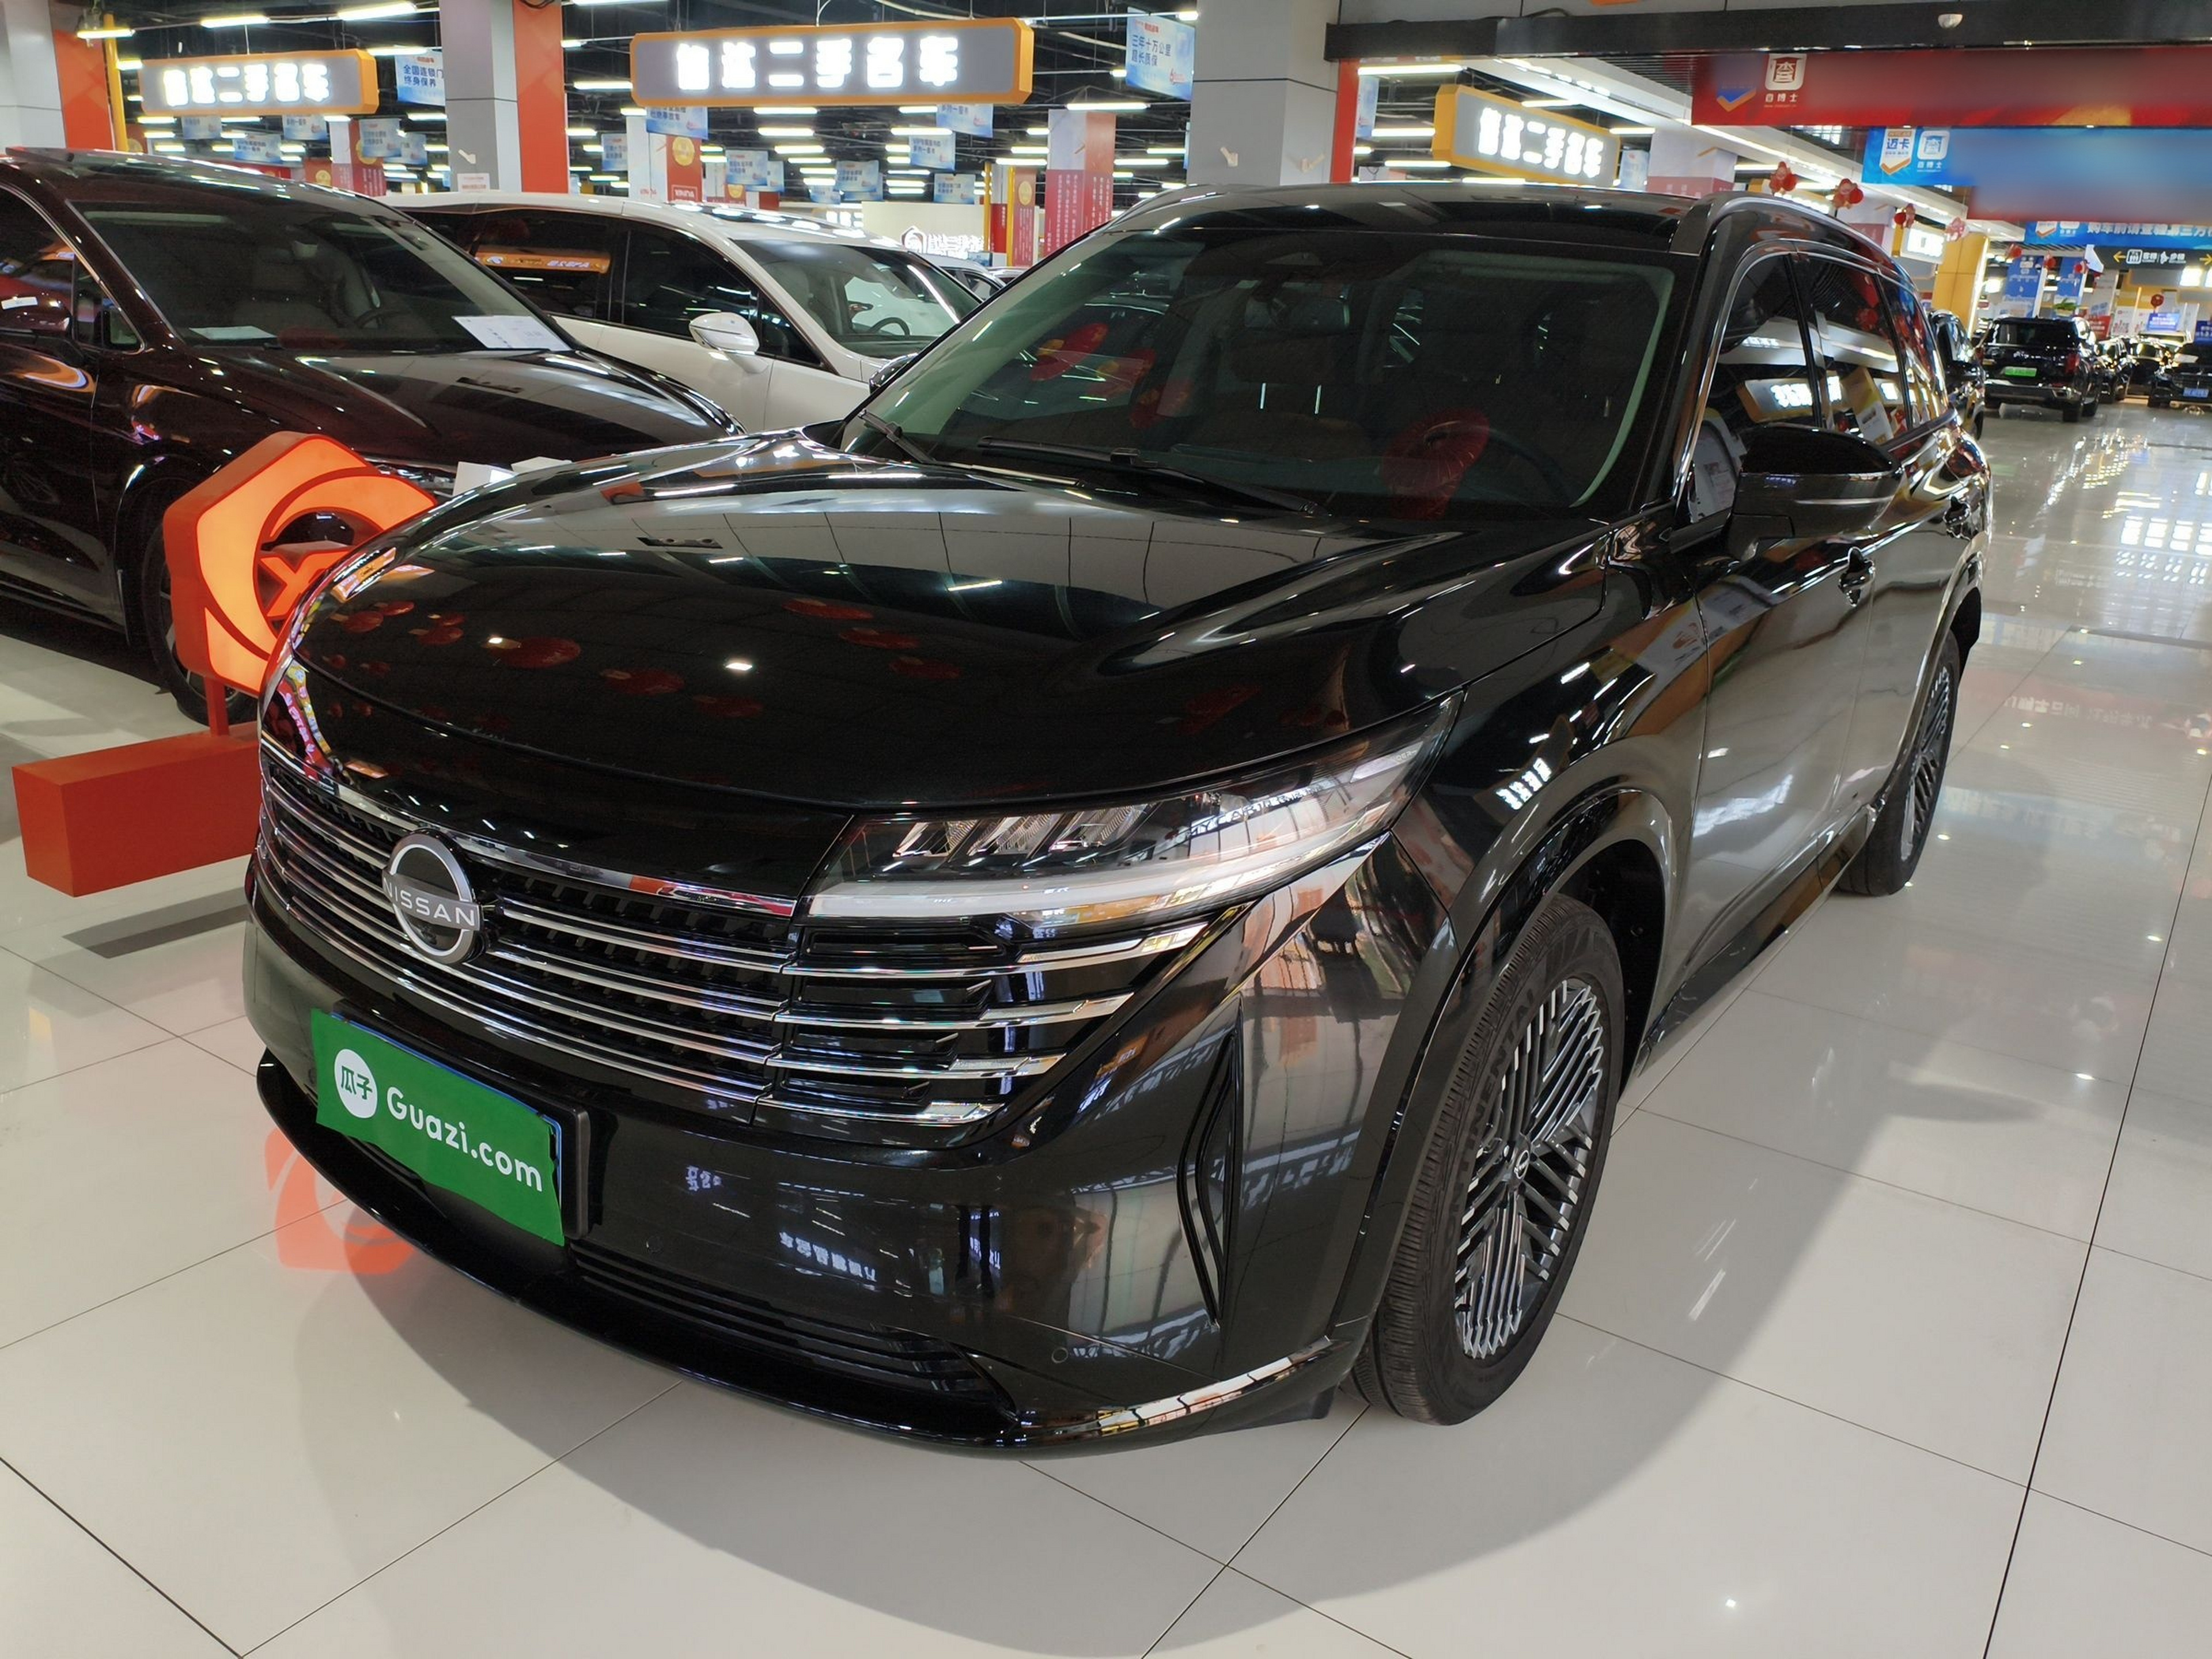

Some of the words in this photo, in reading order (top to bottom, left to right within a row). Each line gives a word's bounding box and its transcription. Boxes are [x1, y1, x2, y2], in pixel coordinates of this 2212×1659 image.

[1132, 35, 1171, 56] 三年十万公里
[1887, 138, 1910, 149] 迈卡
[384, 876, 477, 928] NISSAN
[340, 1065, 373, 1099] 瓜子
[387, 1086, 543, 1192] Guazi.com
